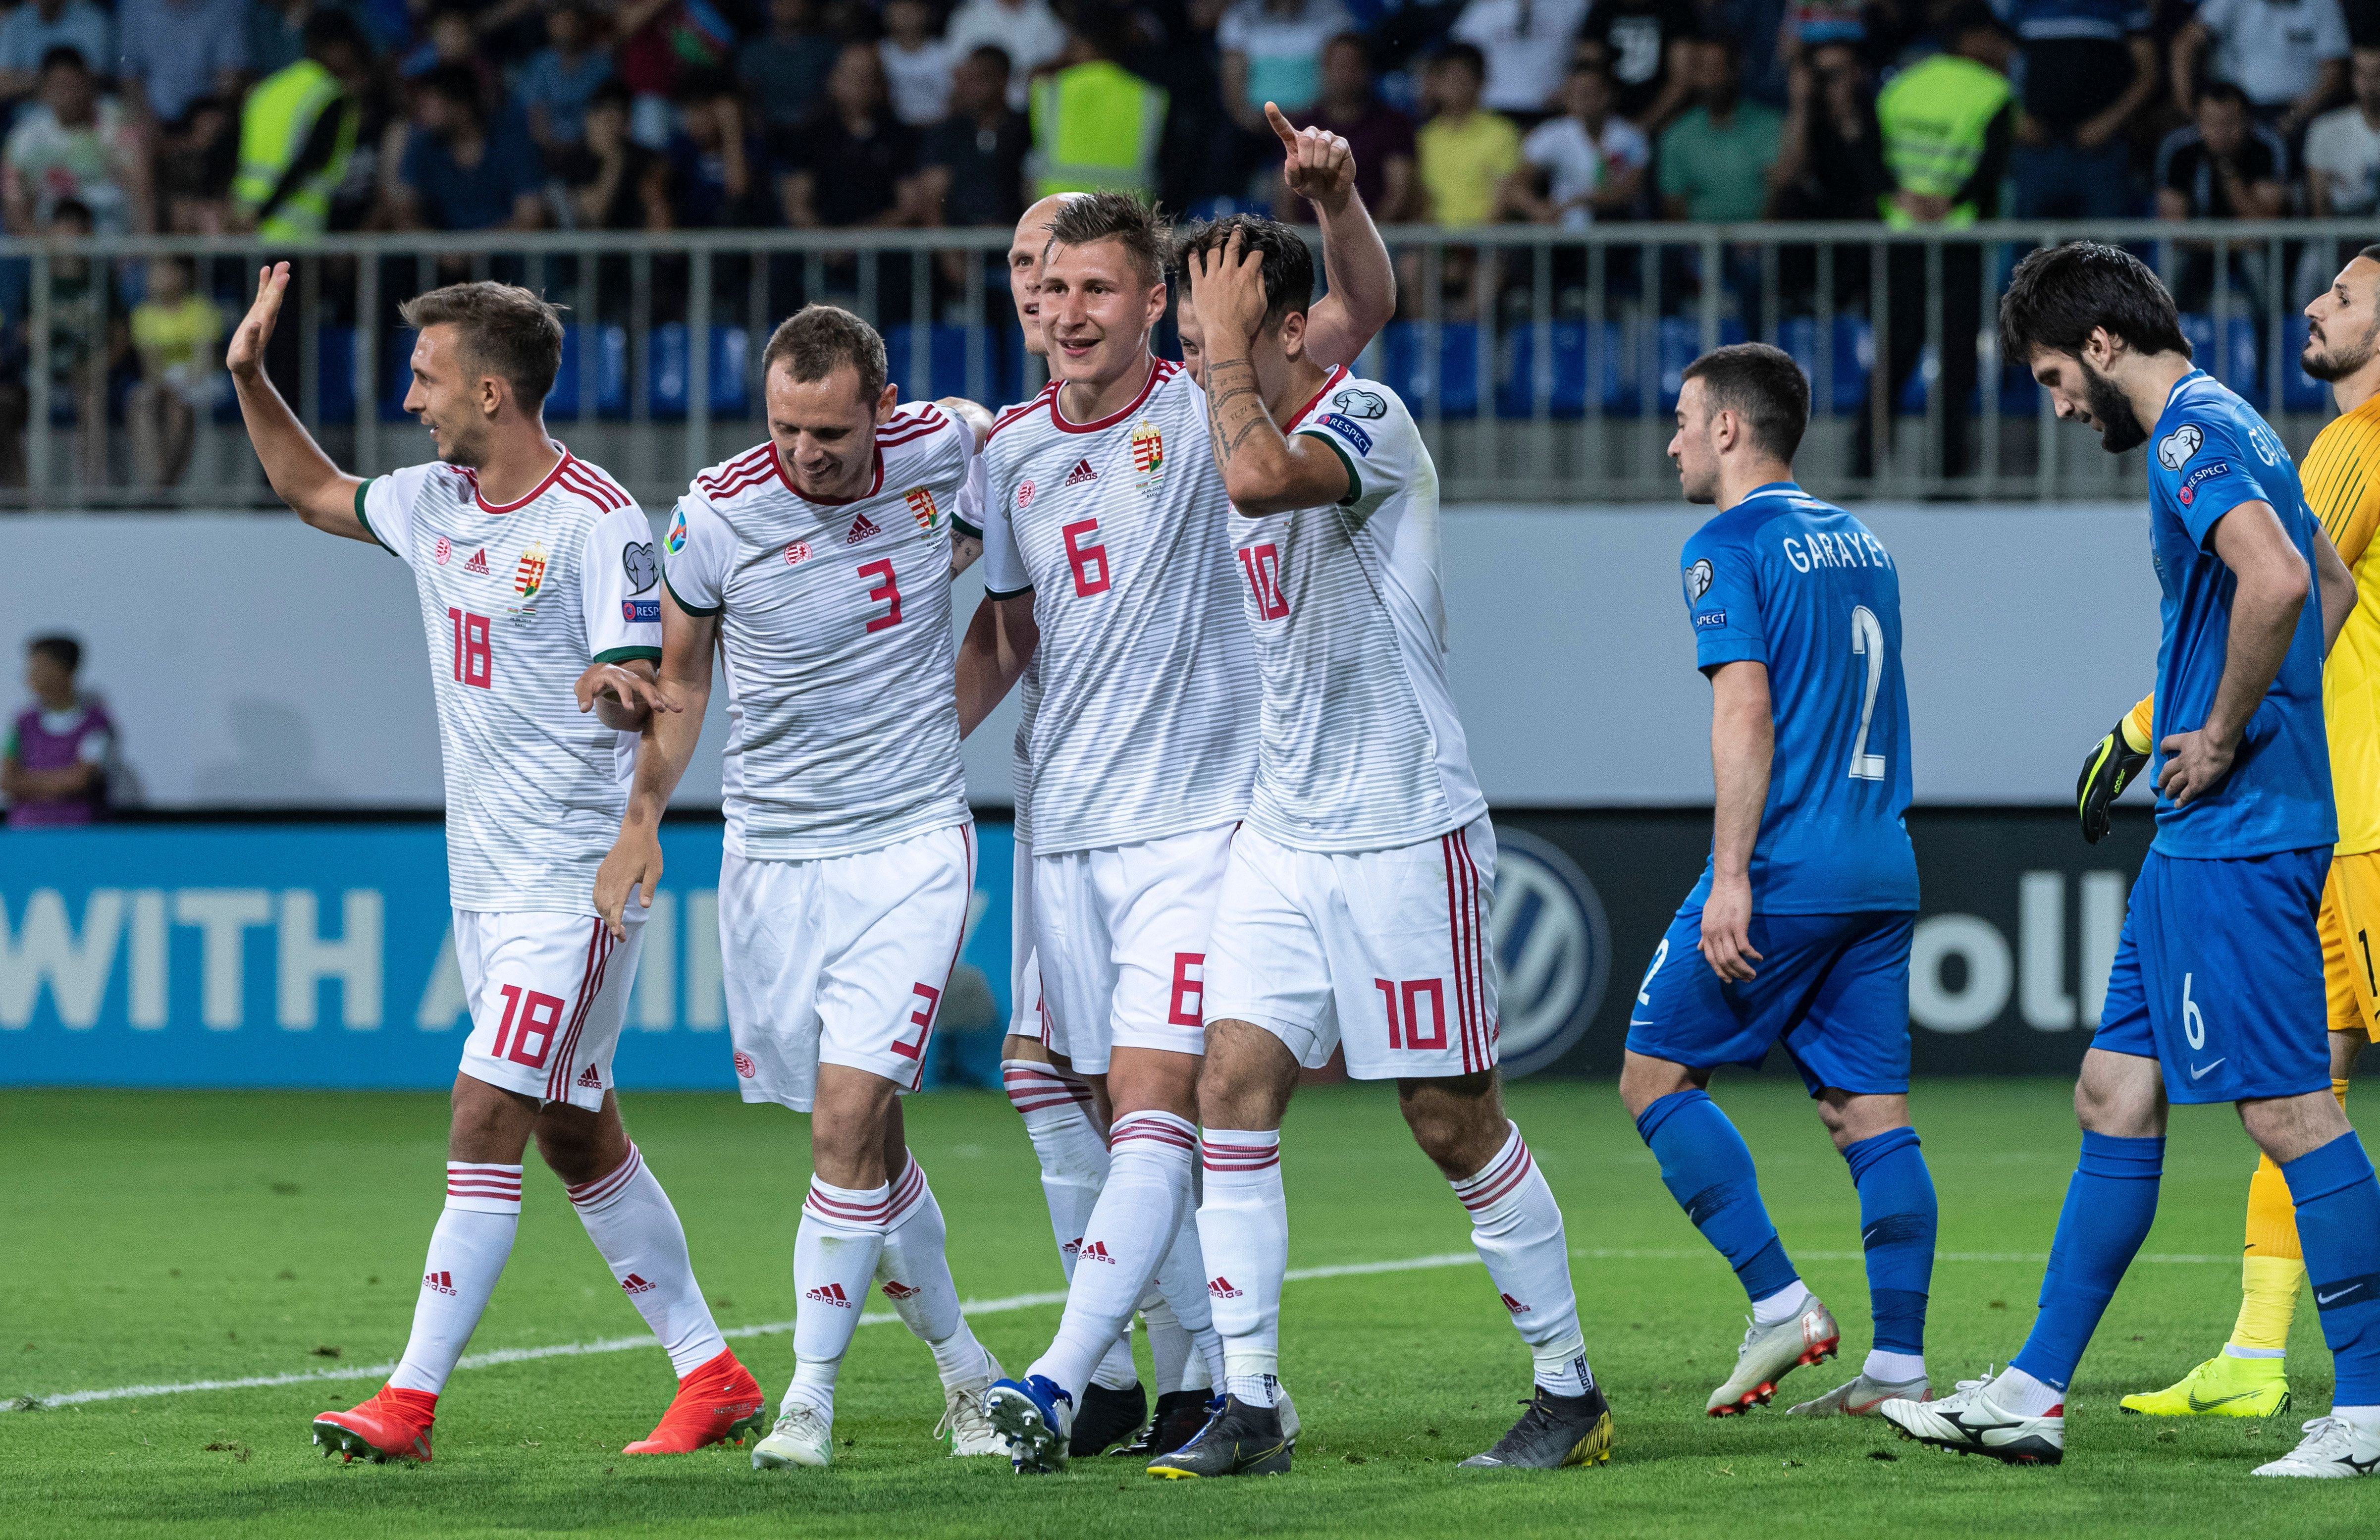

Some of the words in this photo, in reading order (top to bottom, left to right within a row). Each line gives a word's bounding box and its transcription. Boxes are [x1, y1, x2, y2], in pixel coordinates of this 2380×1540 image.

[1329, 418, 1370, 451] RESPECT
[1065, 472, 1098, 487] adidas
[2188, 463, 2227, 490] RESPECT
[464, 562, 489, 575] adidas
[846, 525, 882, 544] adidas
[1062, 518, 1111, 598] 6
[857, 558, 902, 633] 3
[1238, 543, 1290, 621] 10
[448, 607, 491, 689] 18
[1849, 605, 1886, 781] 2
[0, 888, 384, 1030] WITH
[1637, 938, 1669, 1006] 2
[491, 984, 565, 1069] 18
[890, 982, 940, 1062] 3
[1375, 977, 1447, 1050] 10
[2183, 972, 2205, 1050] 6
[577, 1078, 602, 1089] adidas
[624, 1282, 656, 1294] didas
[806, 1292, 852, 1308] adidas
[1209, 1289, 1243, 1298] didas
